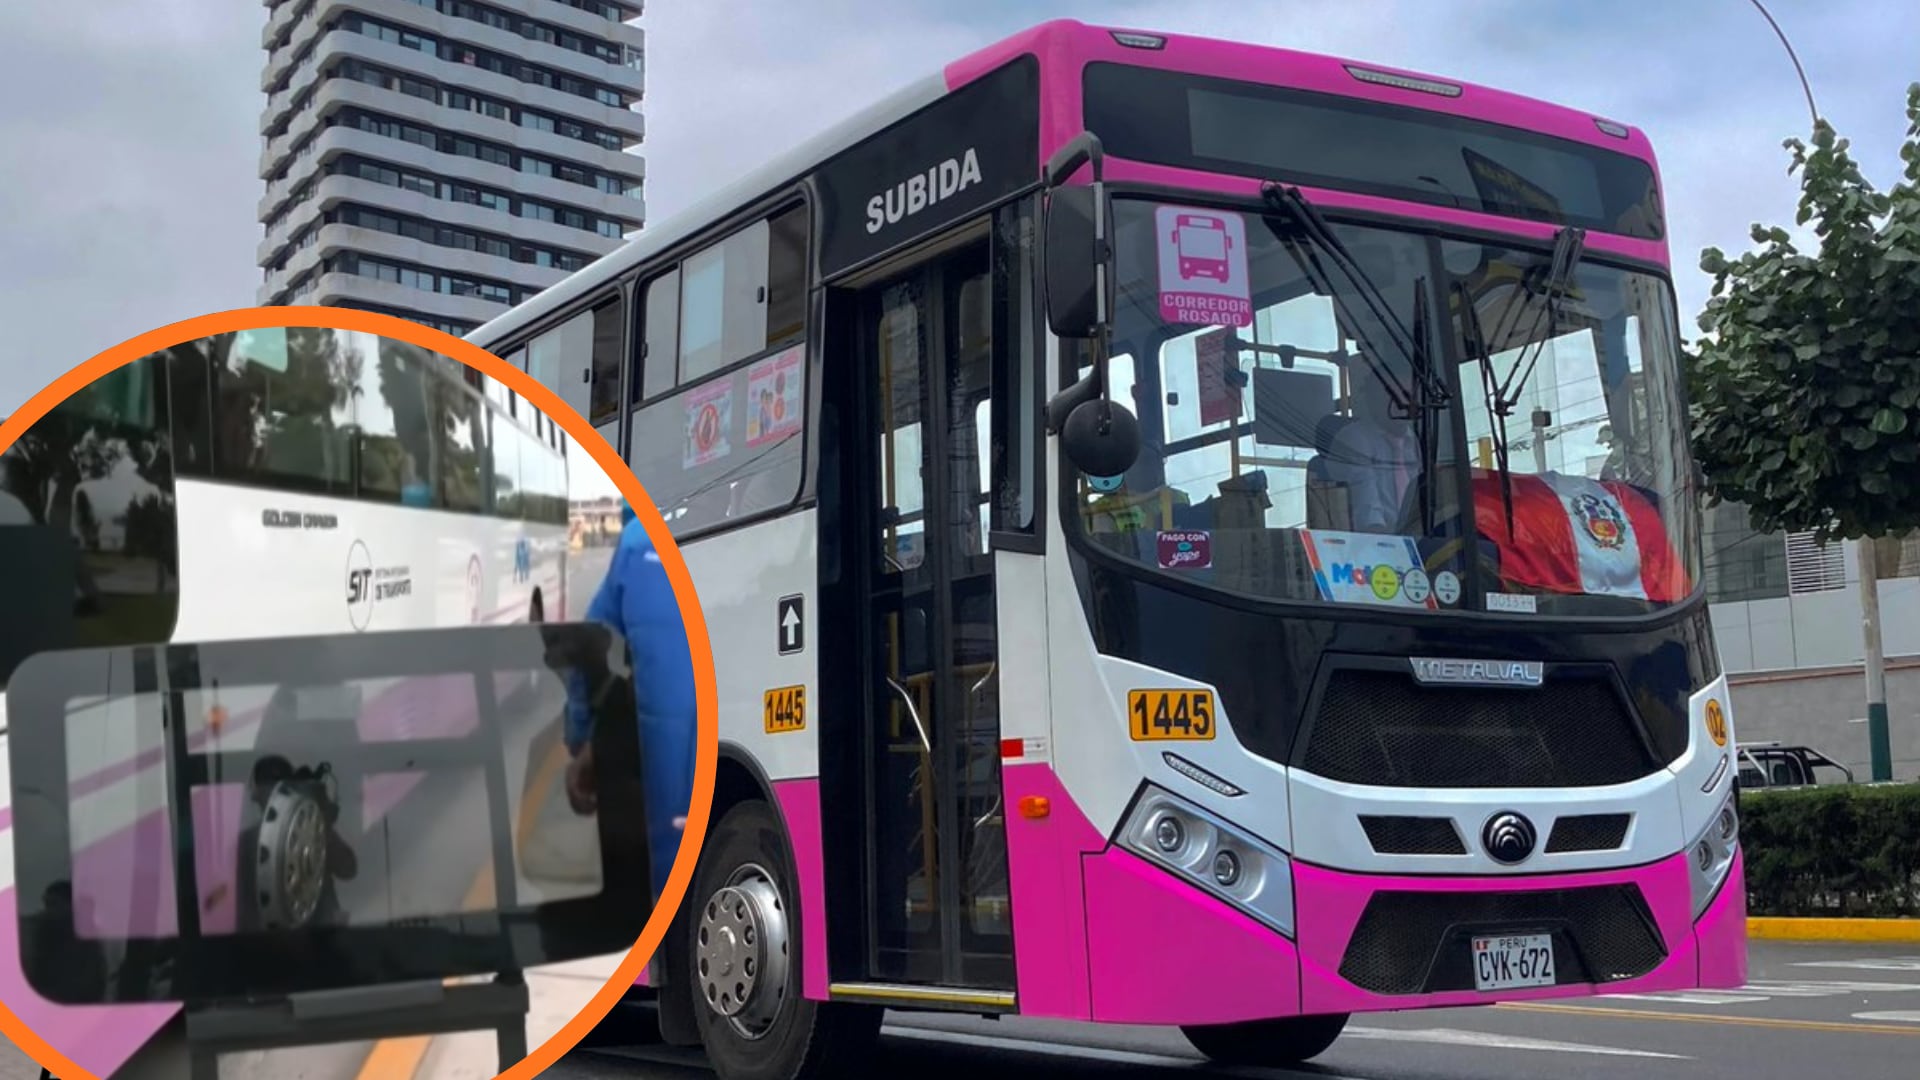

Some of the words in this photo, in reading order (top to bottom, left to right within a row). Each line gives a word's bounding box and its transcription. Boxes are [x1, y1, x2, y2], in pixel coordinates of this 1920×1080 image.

[866, 147, 982, 235] SUBIDA
[1163, 294, 1249, 314] CORREDOR
[1177, 309, 1243, 326] ROSADO
[1162, 533, 1186, 542] PAGO
[1187, 533, 1206, 542] CON
[346, 568, 372, 604] SIT
[1418, 660, 1539, 681] METALVAL
[766, 690, 804, 729] 1445
[1134, 692, 1210, 736] 1445
[1708, 705, 1727, 739] 02
[1499, 937, 1528, 950] PERU
[1478, 947, 1552, 982] CYK-672
